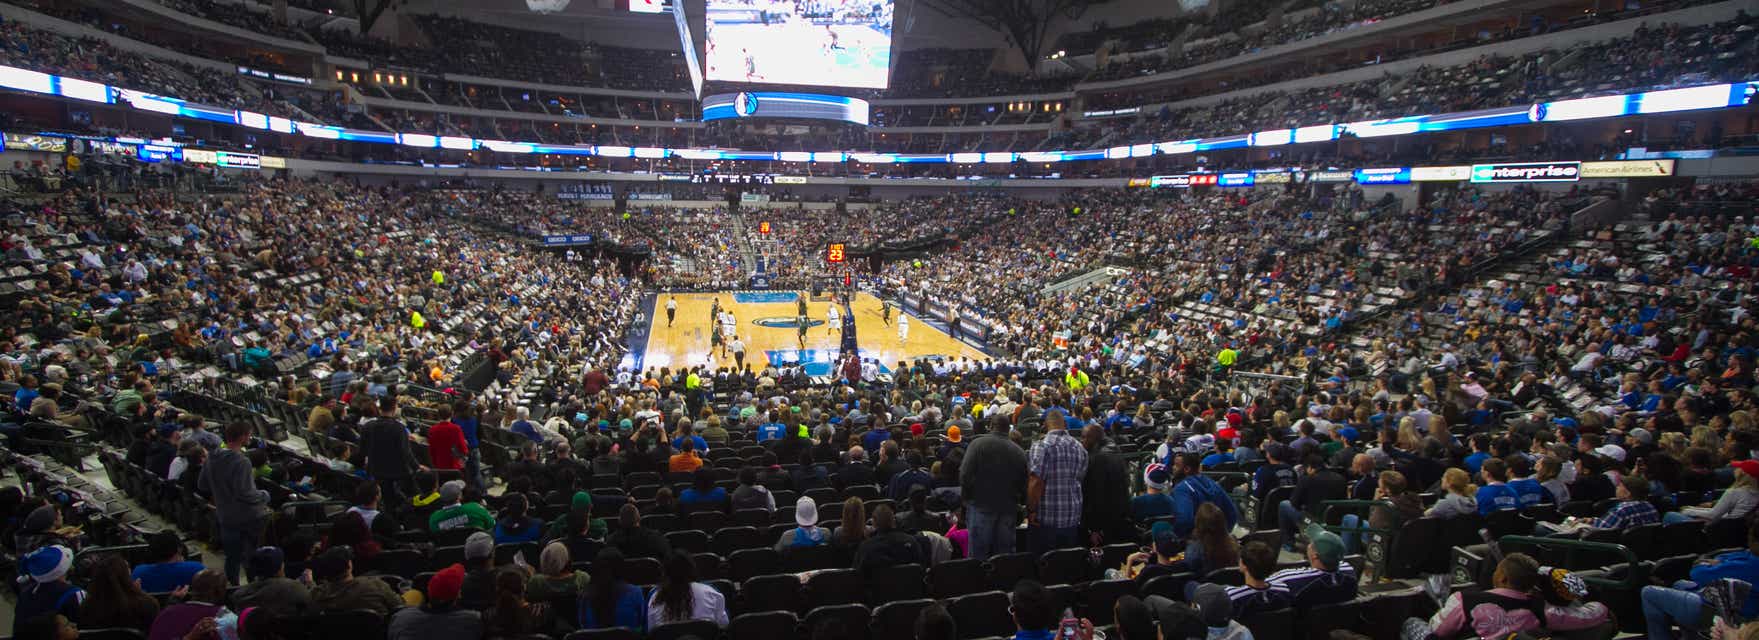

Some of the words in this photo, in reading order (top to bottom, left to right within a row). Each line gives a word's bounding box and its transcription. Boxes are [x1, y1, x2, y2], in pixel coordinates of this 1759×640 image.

[220, 155, 258, 166] enterprise
[1474, 165, 1577, 179] enterprise
[1622, 165, 1653, 173] Airlines
[829, 249, 843, 260] 23
